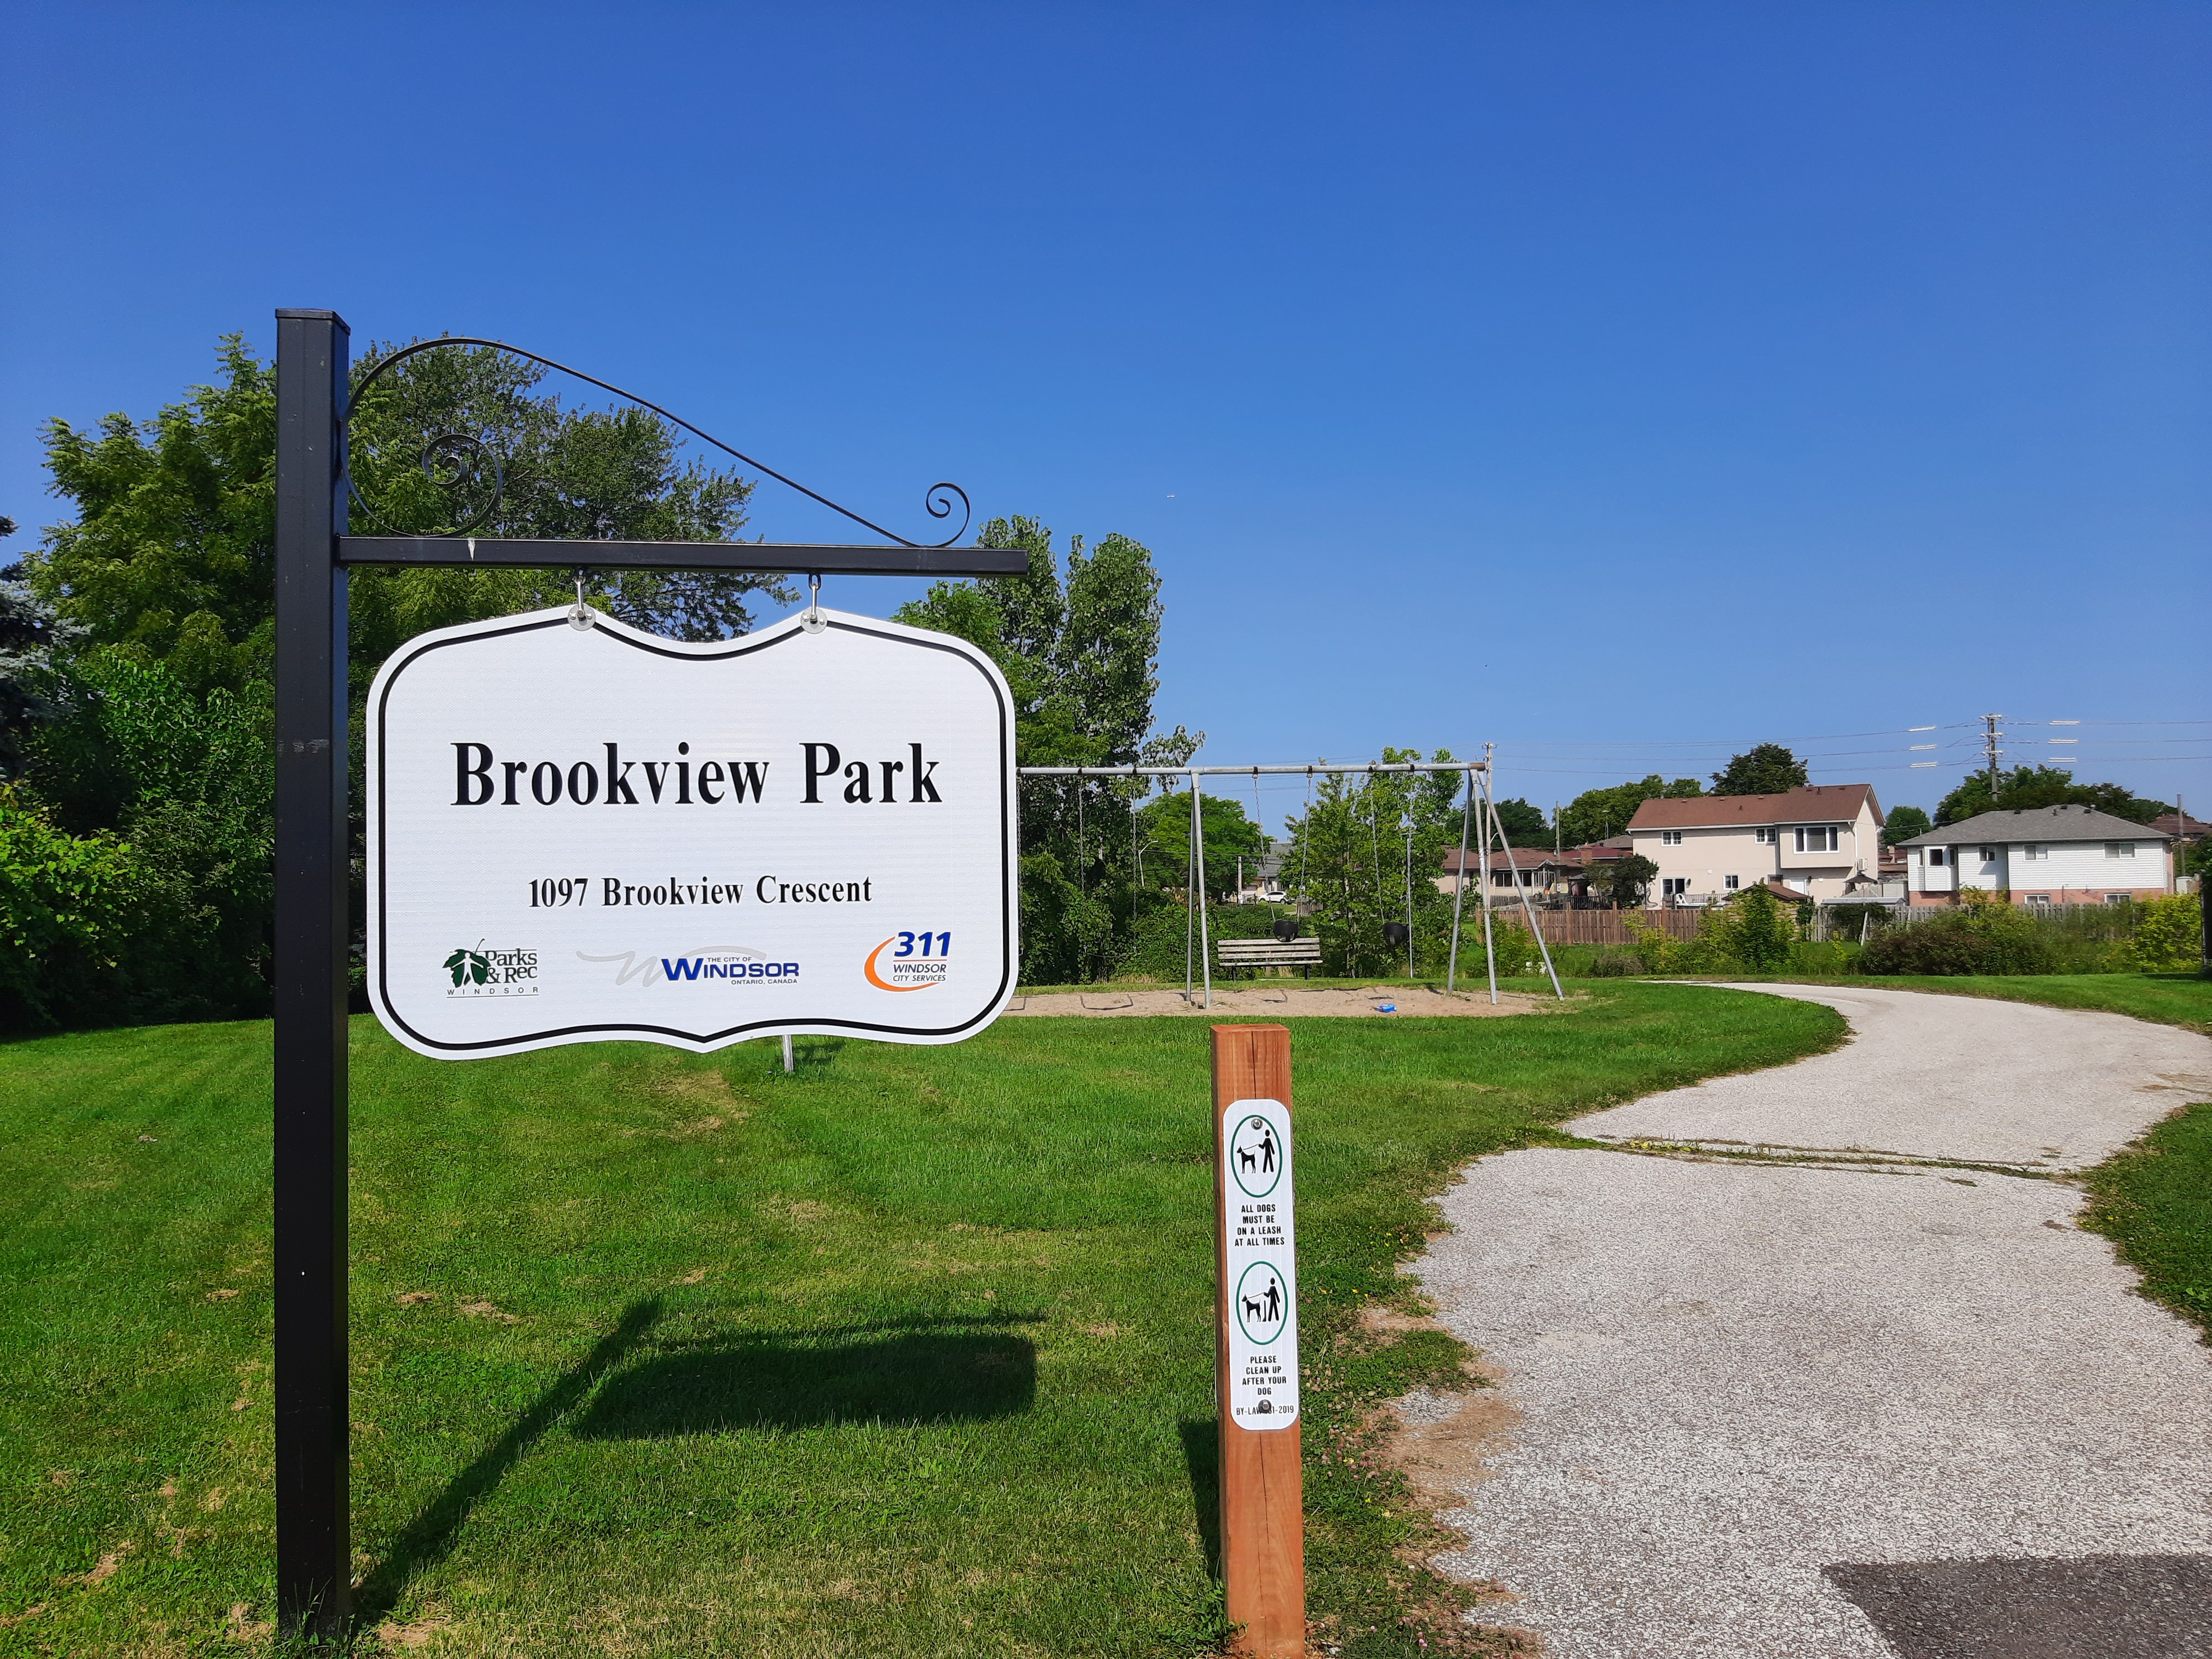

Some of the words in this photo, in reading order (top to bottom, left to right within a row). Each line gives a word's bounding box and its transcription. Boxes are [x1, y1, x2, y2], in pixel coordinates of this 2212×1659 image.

[450, 742, 770, 806] Brookview
[799, 743, 942, 804] Park
[529, 878, 588, 907] 1097
[602, 876, 743, 906] Brookview
[757, 875, 872, 904] Crescent
[894, 931, 951, 957] 311
[484, 948, 538, 967] Parks
[661, 958, 799, 980] WINDSOR
[893, 964, 947, 973] WINDSOR
[487, 968, 501, 984] &
[503, 966, 538, 983] Rec
[447, 987, 539, 995] WINDSOR
[1241, 1204, 1254, 1213] ALL
[1257, 1204, 1276, 1212] DOGS
[1243, 1215, 1262, 1224] MUST
[1266, 1215, 1275, 1223] BE
[1237, 1227, 1247, 1235] ON
[1250, 1227, 1255, 1235] A
[1258, 1226, 1281, 1235] LEASH
[1234, 1238, 1243, 1246] AT
[1246, 1238, 1259, 1246] ALL
[1262, 1237, 1285, 1245] TIMES
[1250, 1355, 1276, 1364] PLEASE
[1246, 1366, 1269, 1375] CLEAN
[1242, 1377, 1265, 1385] AFTER
[1267, 1376, 1286, 1384] YOUR
[1258, 1387, 1271, 1395] DOG
